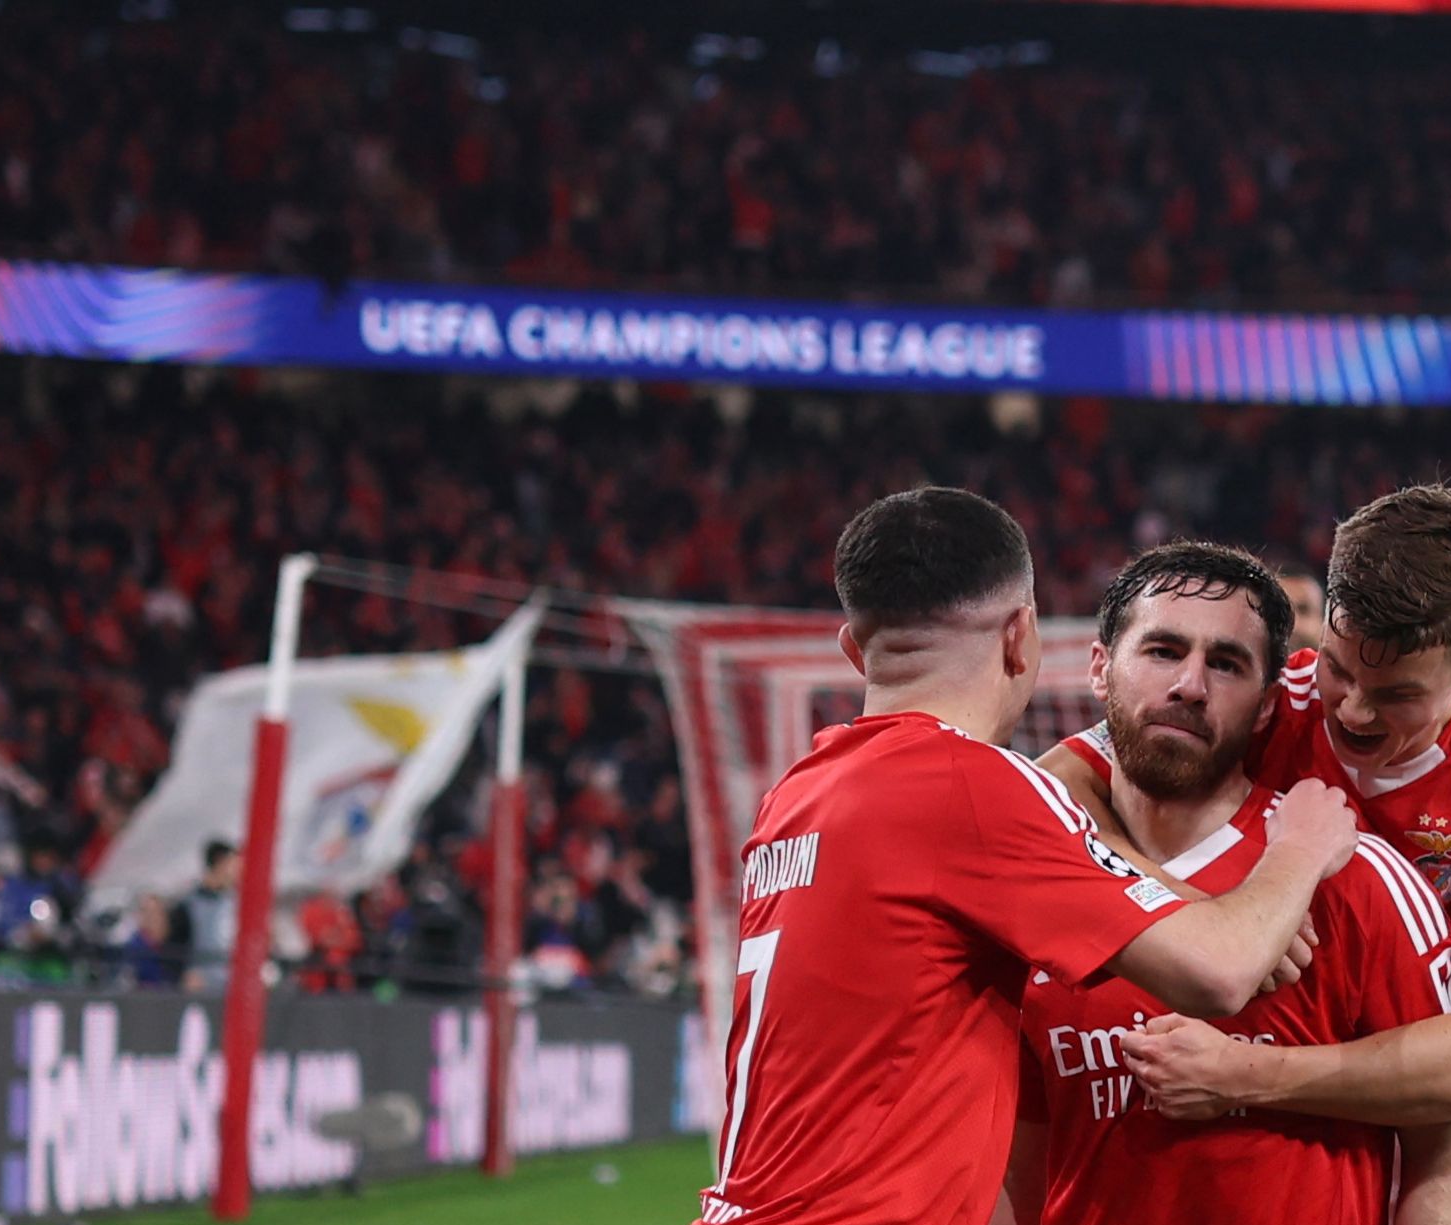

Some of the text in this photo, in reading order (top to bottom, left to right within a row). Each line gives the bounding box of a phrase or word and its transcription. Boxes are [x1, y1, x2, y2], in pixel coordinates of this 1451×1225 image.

[361, 301, 1045, 379] UEFA CHAMPIONS LEAGUE
[743, 832, 820, 905] MDOUNI
[721, 929, 781, 1182] 7
[1091, 1075, 1133, 1120] FLY
